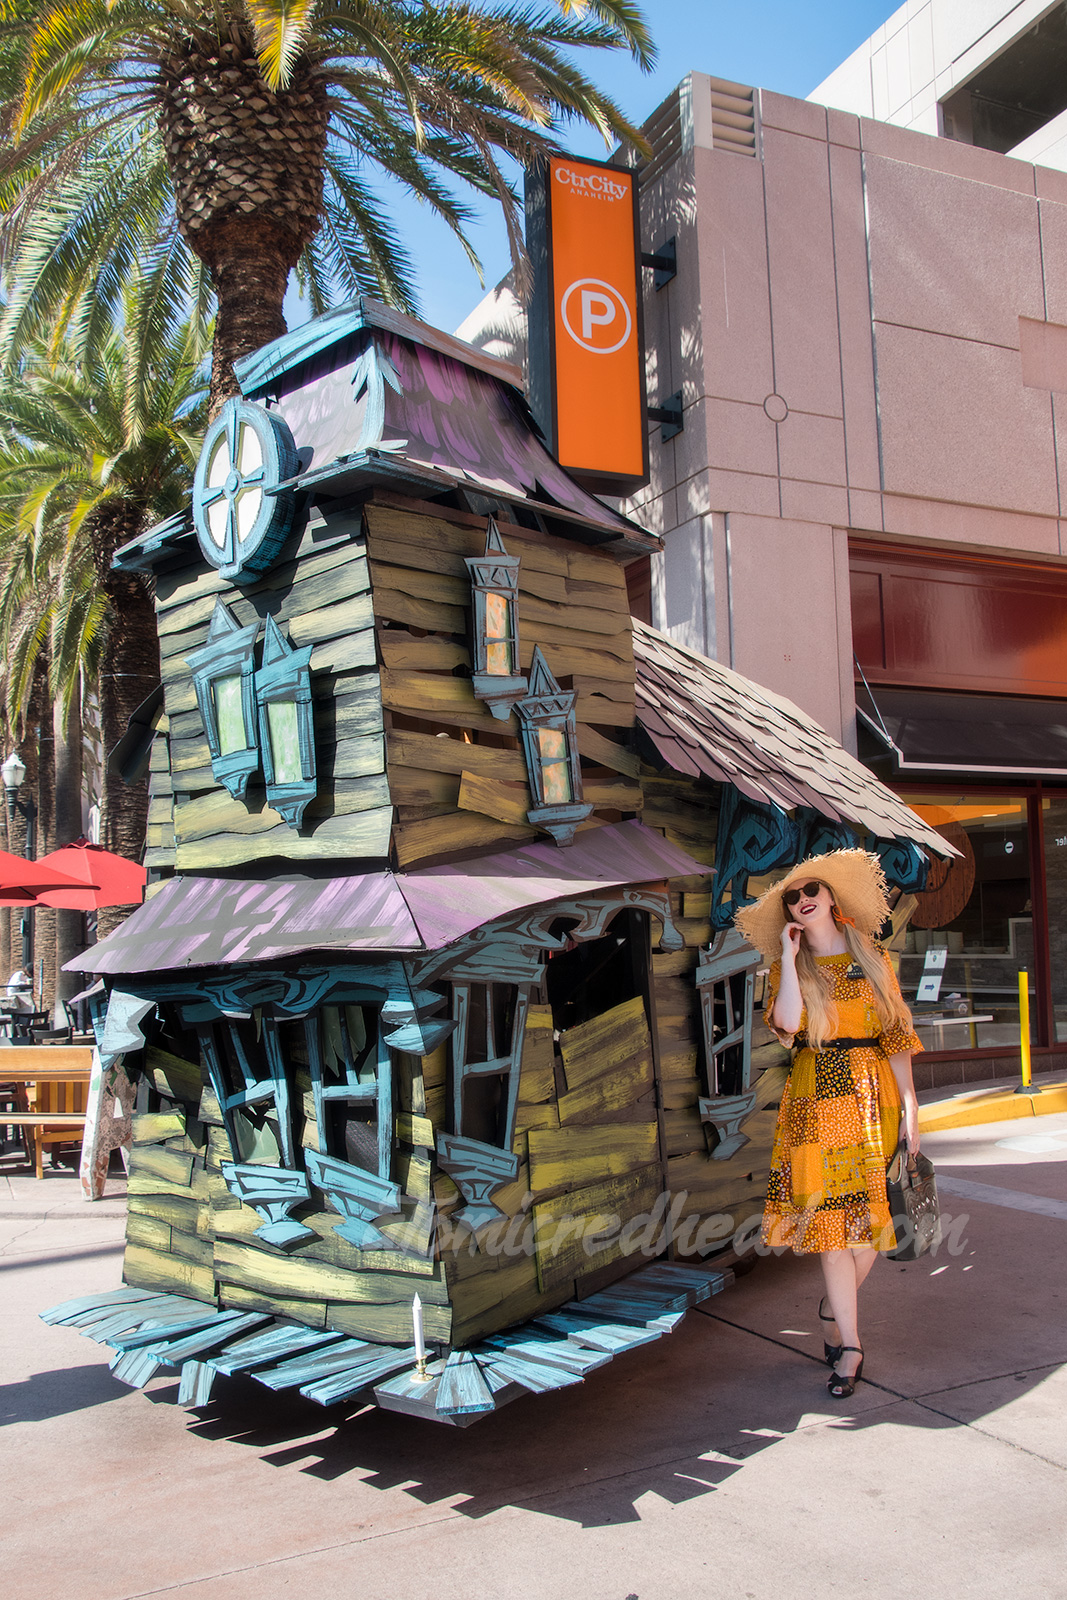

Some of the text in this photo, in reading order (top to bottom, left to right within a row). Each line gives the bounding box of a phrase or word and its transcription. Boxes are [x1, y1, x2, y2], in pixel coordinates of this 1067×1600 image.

[555, 167, 628, 199] CtrCity
[570, 187, 614, 202] ANAHEIM
[581, 290, 616, 339] P
